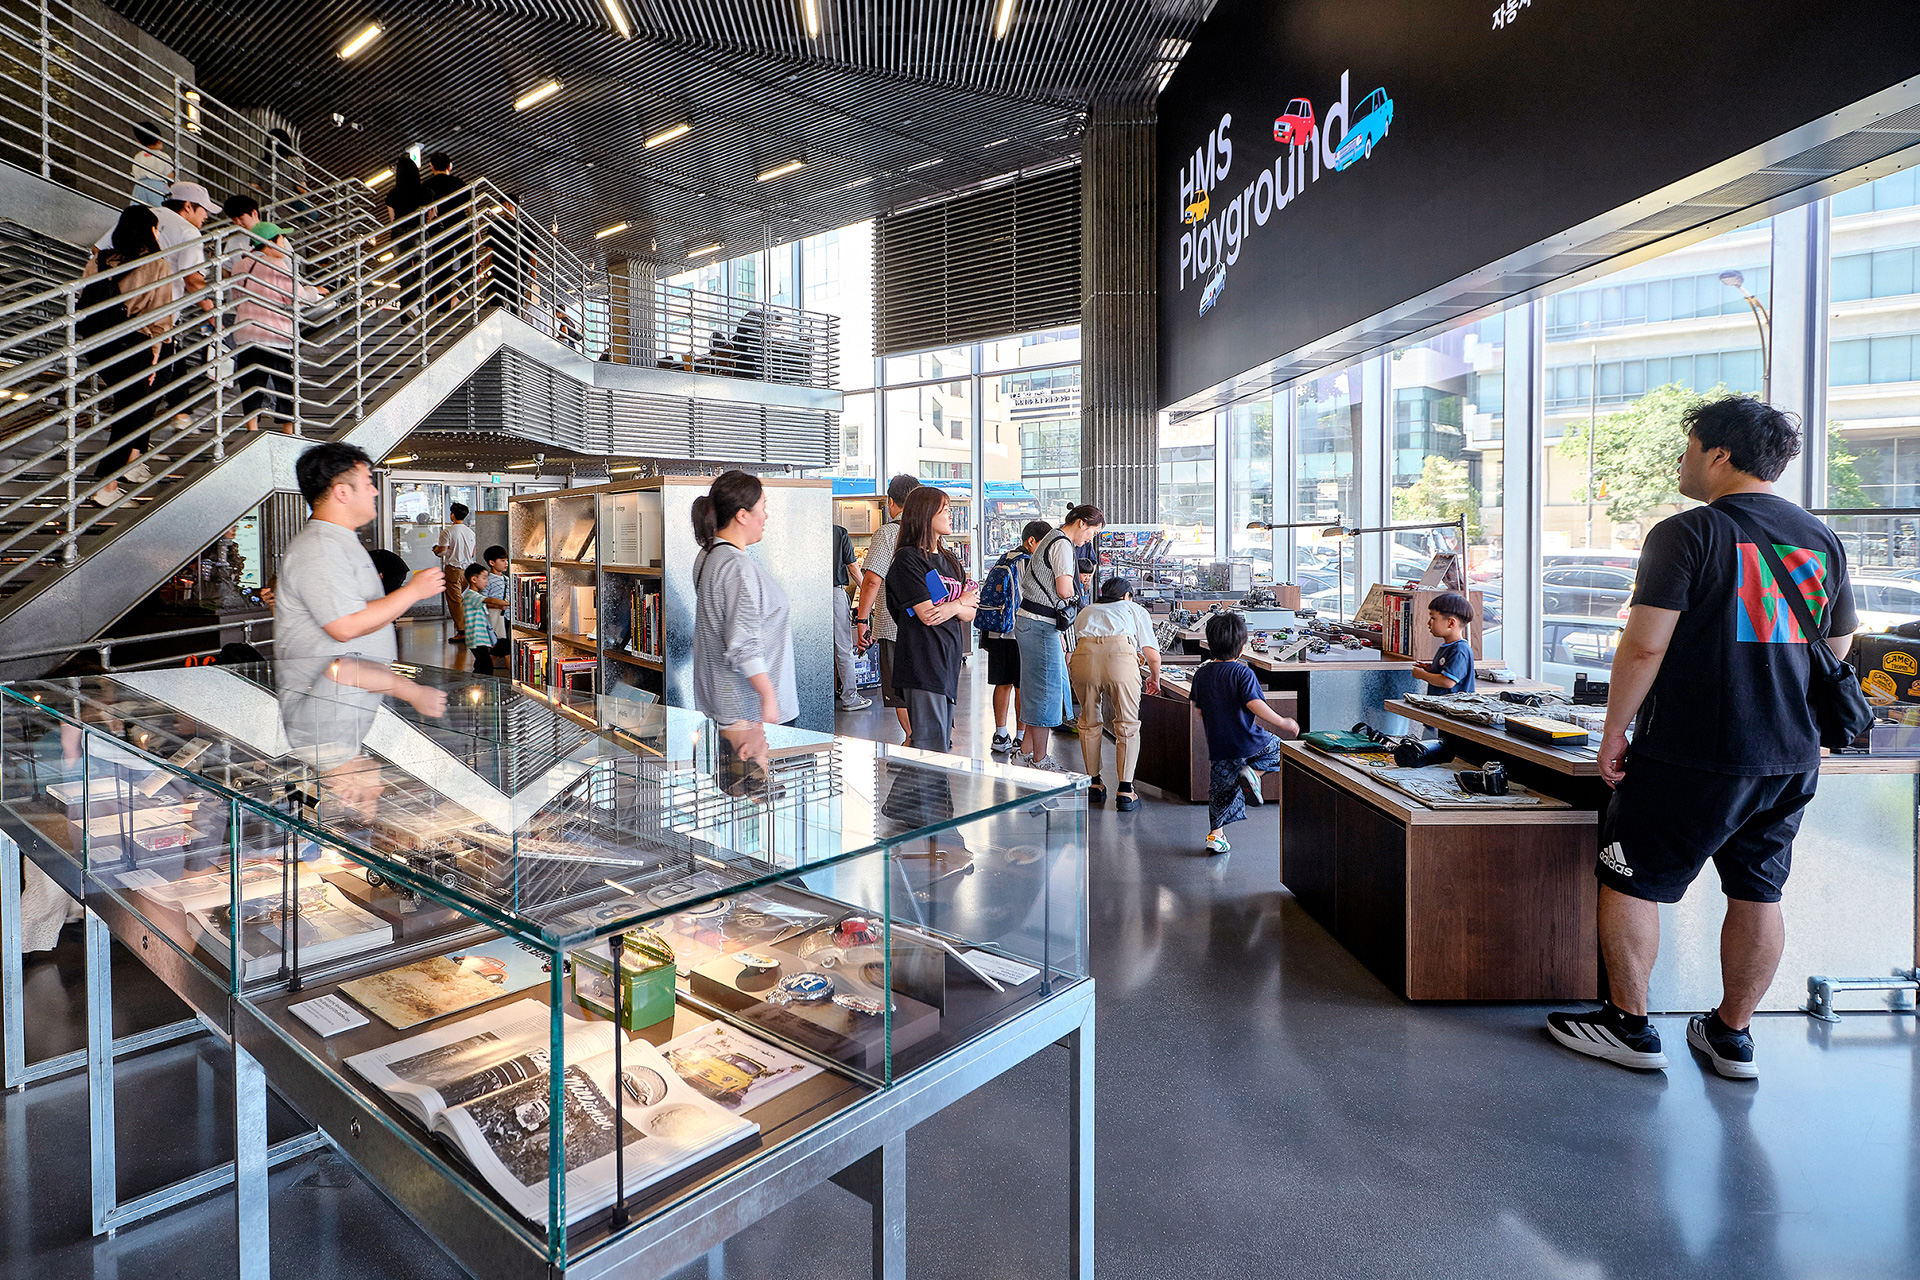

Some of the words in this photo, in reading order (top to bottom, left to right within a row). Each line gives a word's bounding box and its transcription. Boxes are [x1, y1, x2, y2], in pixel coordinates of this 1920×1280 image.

[1179, 112, 1233, 224] HMS
[1179, 68, 1350, 292] Playground
[1885, 655, 1915, 670] CAMEL
[1599, 851, 1634, 877] adidas
[563, 1075, 615, 1131] Millionen
